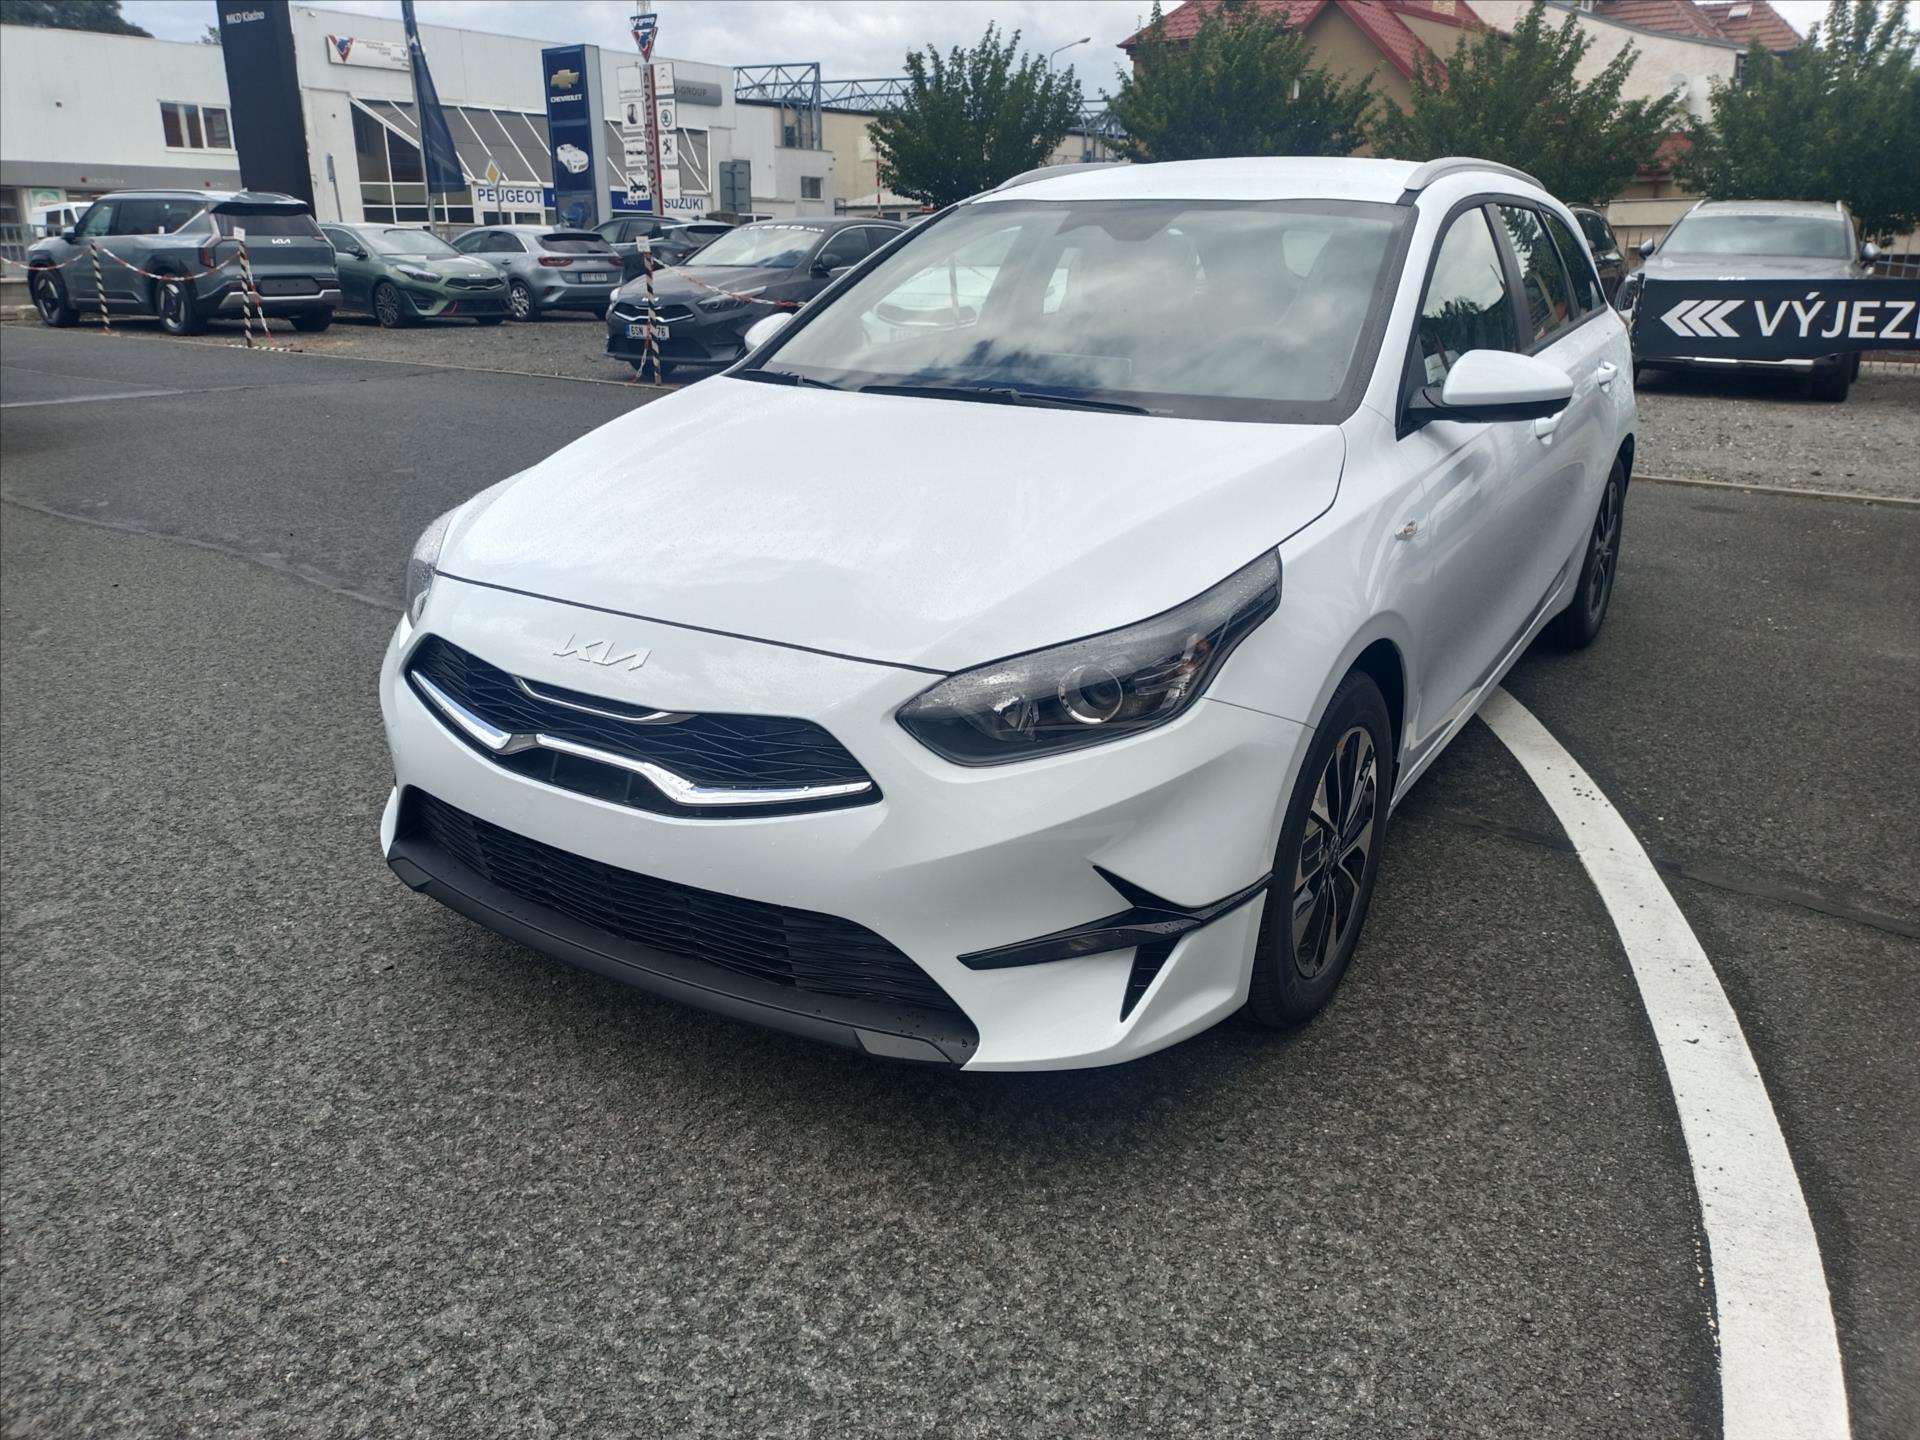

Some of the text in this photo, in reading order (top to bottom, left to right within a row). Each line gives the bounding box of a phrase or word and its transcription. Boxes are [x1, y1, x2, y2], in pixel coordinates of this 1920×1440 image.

[477, 188, 542, 204] PEUGEOT
[664, 197, 704, 210] SUZUKI
[1754, 291, 1920, 339] VÝJEZ
